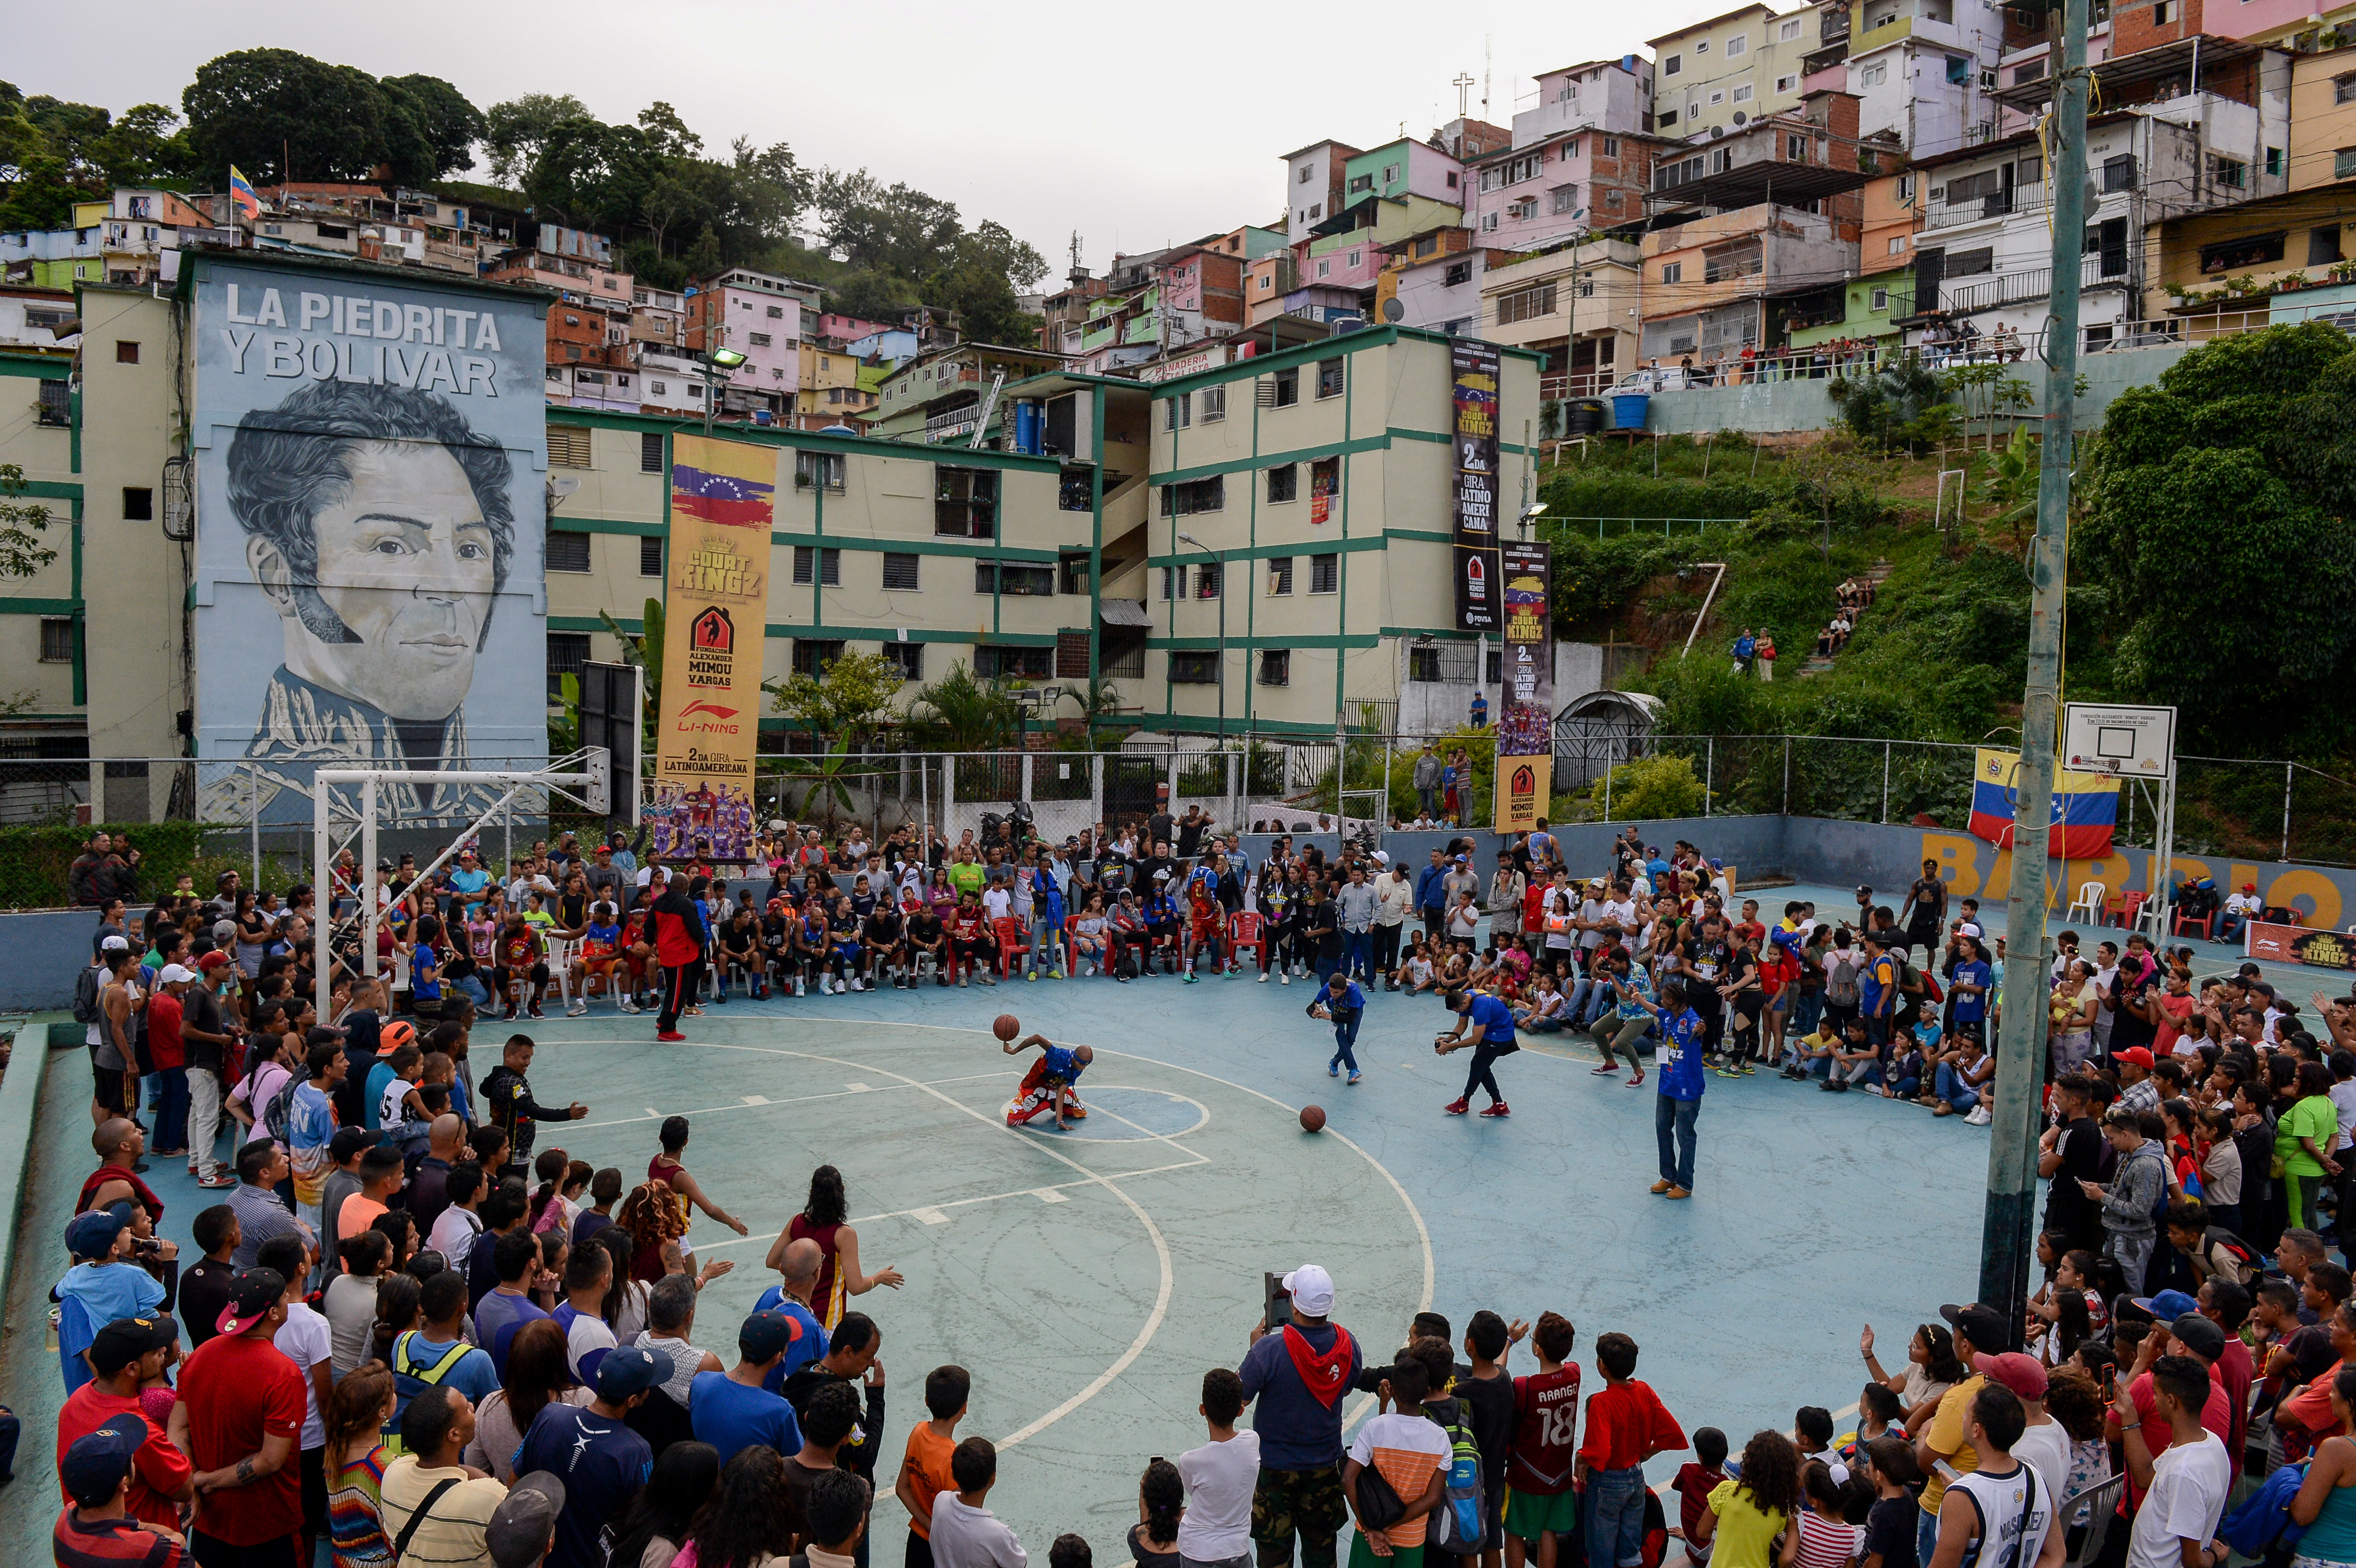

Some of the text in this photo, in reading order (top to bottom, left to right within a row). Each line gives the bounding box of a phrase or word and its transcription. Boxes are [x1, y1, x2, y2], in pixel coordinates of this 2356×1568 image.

[227, 283, 502, 352] LA PIEDRITA
[220, 329, 499, 398] Y BOLIVAR
[1156, 353, 1208, 375] PANADERIA
[1462, 410, 1488, 421] COURT
[1458, 418, 1494, 435] KINGZ
[1464, 474, 1484, 489] GIRA
[1461, 487, 1491, 503] LATINO
[1462, 502, 1490, 517] AMERI
[1463, 516, 1487, 530] CANA
[687, 549, 751, 571] COURT
[675, 564, 761, 597] KINGZ
[1512, 616, 1538, 625] COURT
[1506, 624, 1543, 640] KINGZ
[689, 653, 732, 662] ALEXANDER
[688, 661, 732, 675] MIMOU
[1517, 666, 1532, 674] GIRA
[688, 675, 731, 686] VARGAS
[1515, 674, 1535, 682] LATINO
[1515, 683, 1535, 691] AMERI
[1516, 691, 1534, 700] CANA
[677, 721, 739, 734] LI-NING
[710, 753, 730, 762] GIRA
[665, 761, 748, 773] LATINOAMERICANA
[1511, 803, 1534, 812] MIMOU
[1511, 811, 1533, 820] VARGAS
[2309, 942, 2344, 953] COURT
[2302, 947, 2349, 965] KINGZ
[1538, 1383, 1577, 1403] ARANGO
[1537, 1401, 1576, 1447] 18
